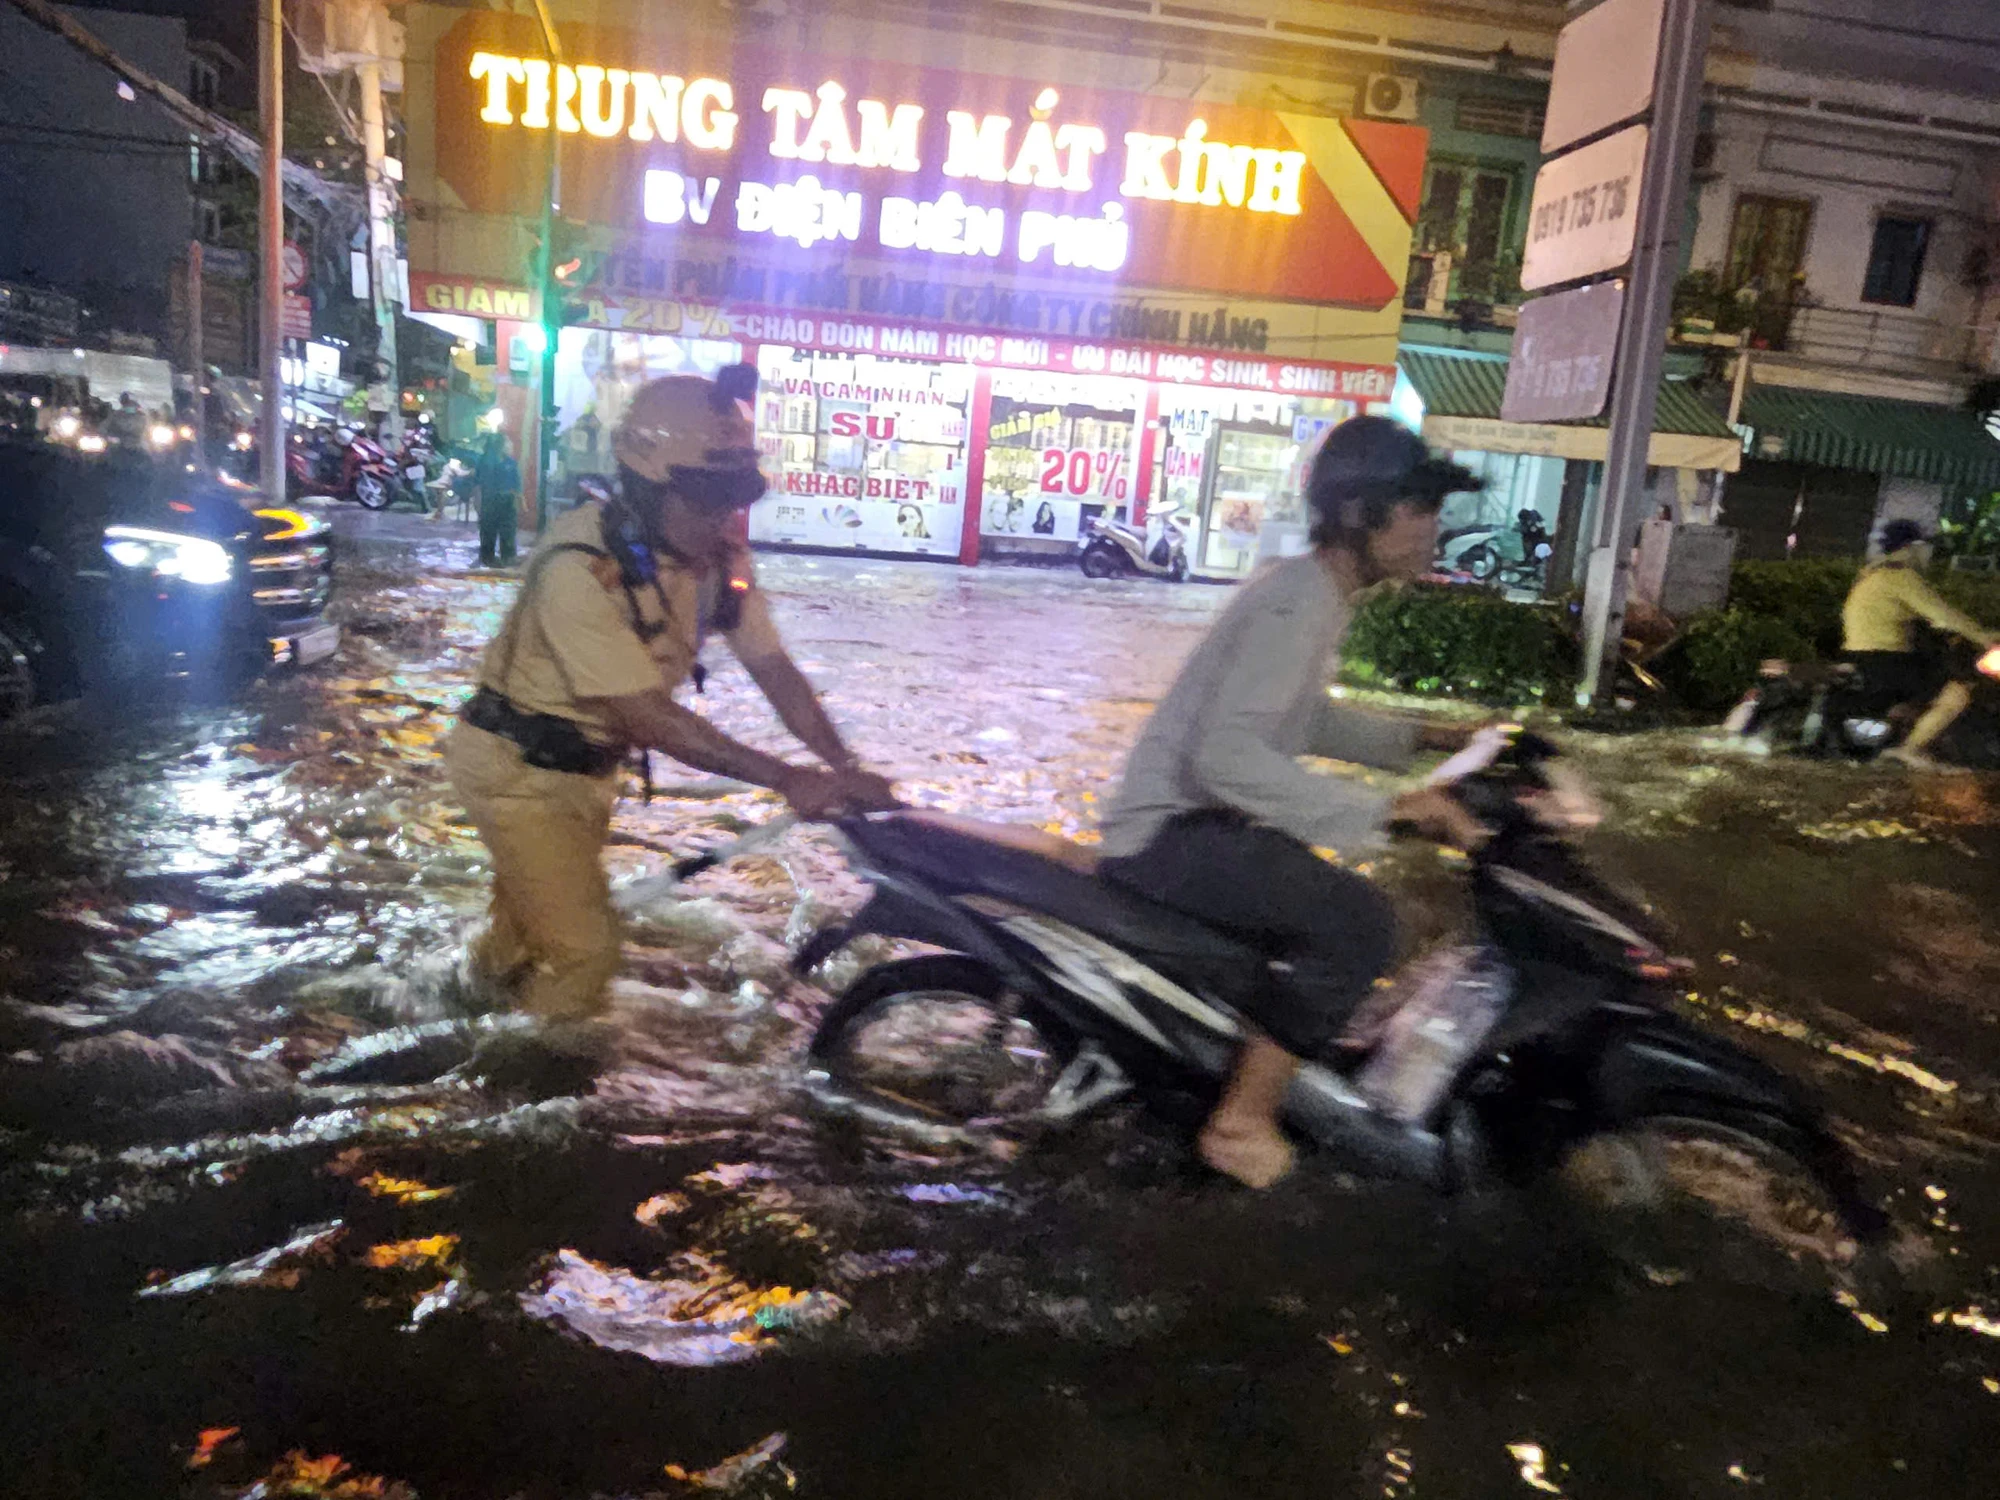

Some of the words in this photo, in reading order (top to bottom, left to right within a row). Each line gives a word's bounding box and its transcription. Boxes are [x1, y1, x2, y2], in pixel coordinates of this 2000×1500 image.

[469, 51, 738, 151] TRUNG
[762, 80, 924, 172] TÂM
[1120, 119, 1306, 215] KÍNH
[643, 169, 720, 224] BV
[735, 174, 862, 248] ĐIỆN
[879, 190, 1004, 257] BIÊN
[1018, 201, 1128, 271] PHỦ
[621, 296, 731, 336] 20%
[945, 333, 996, 363] HỌC
[1156, 353, 1205, 382] HỌC
[1210, 356, 1273, 389] SINH,
[1278, 365, 1337, 392] SINH
[1041, 449, 1127, 499] 20%
